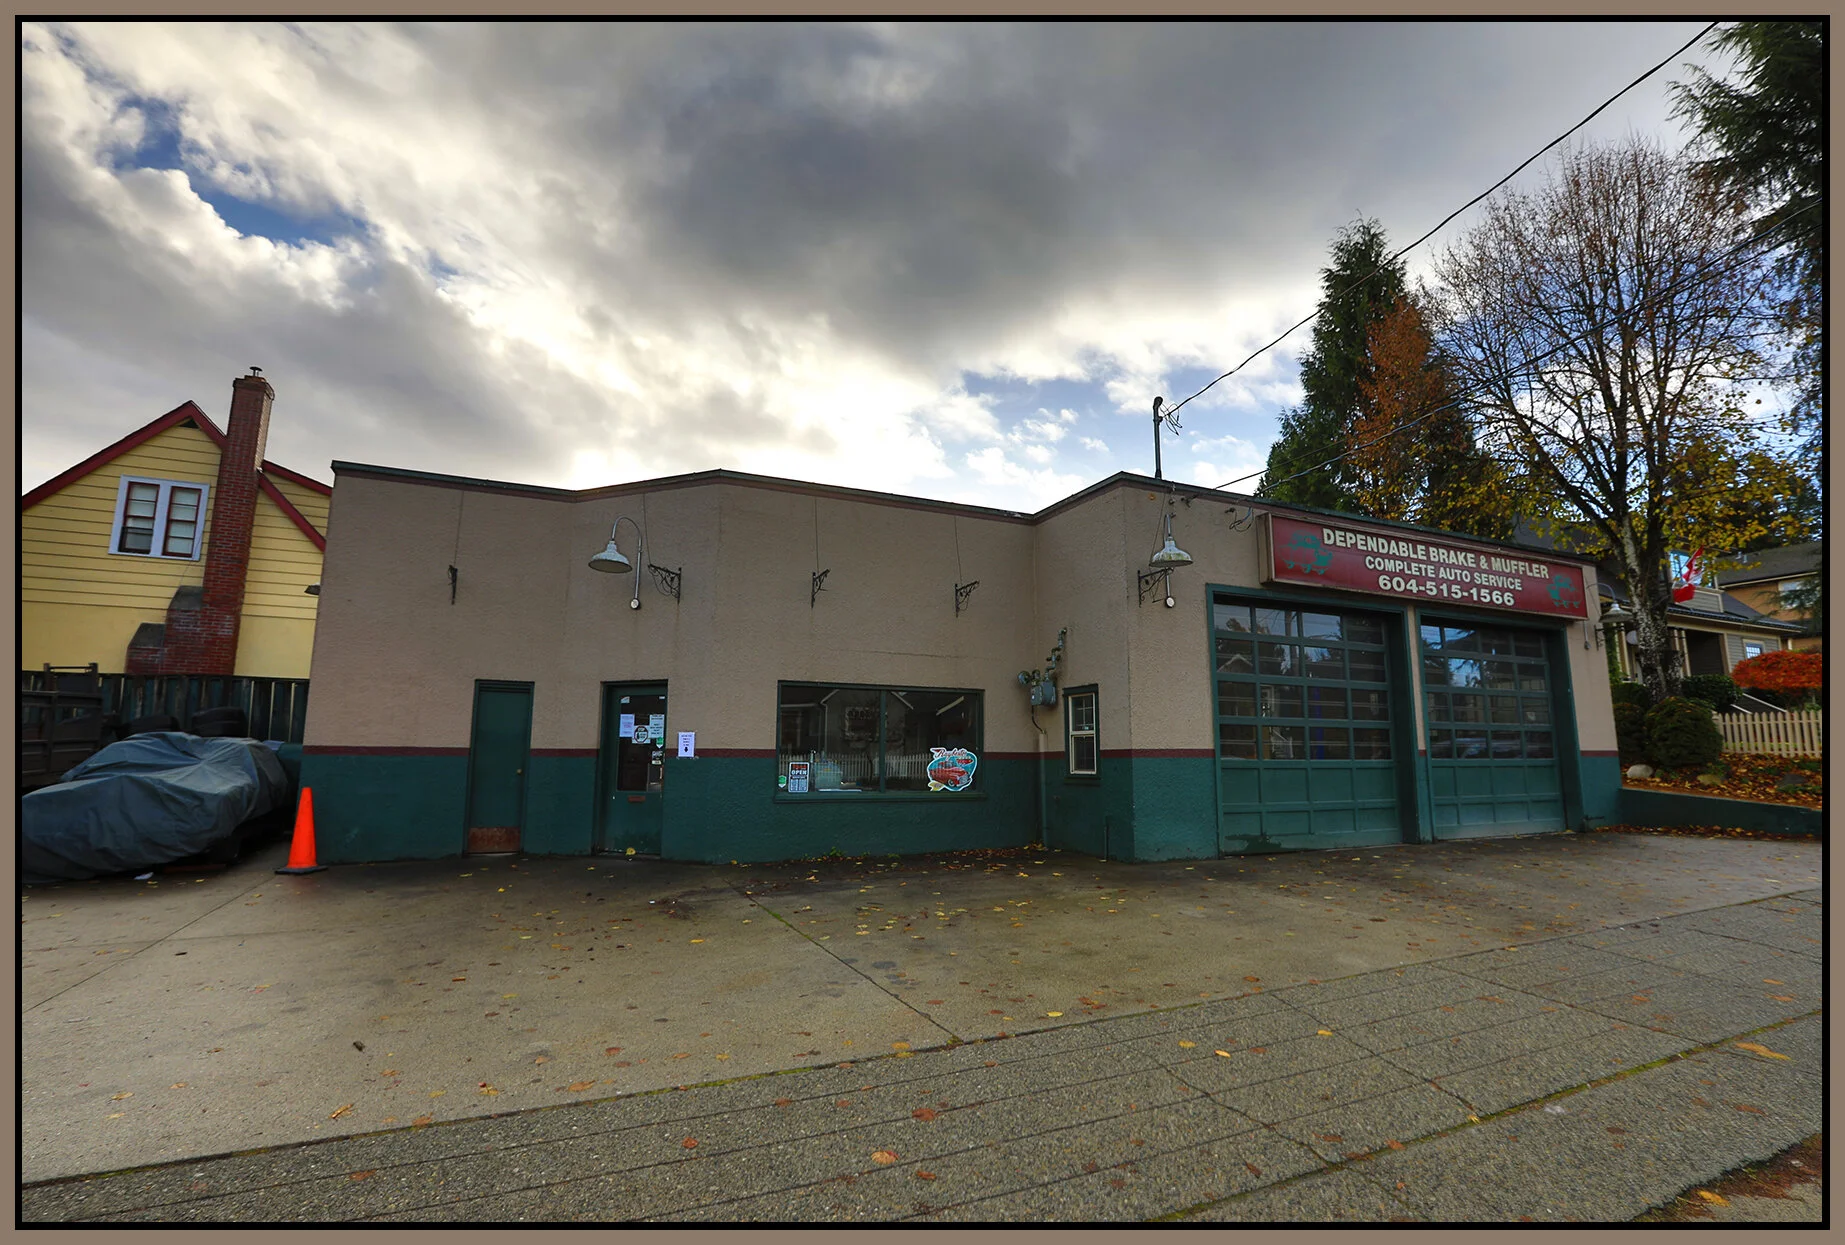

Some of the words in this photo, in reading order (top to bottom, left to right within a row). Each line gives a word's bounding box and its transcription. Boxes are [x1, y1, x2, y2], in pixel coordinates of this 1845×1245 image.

[1322, 528, 1427, 560] DEPENDABLE
[1429, 547, 1476, 568] BRAKE
[1479, 555, 1489, 570] &
[1491, 556, 1550, 579] MUFFLER
[1365, 555, 1436, 578] COMPLETE
[1438, 568, 1471, 583] AUTO
[1473, 573, 1523, 591] SERVICE
[1378, 574, 1515, 606] 604-515-1566
